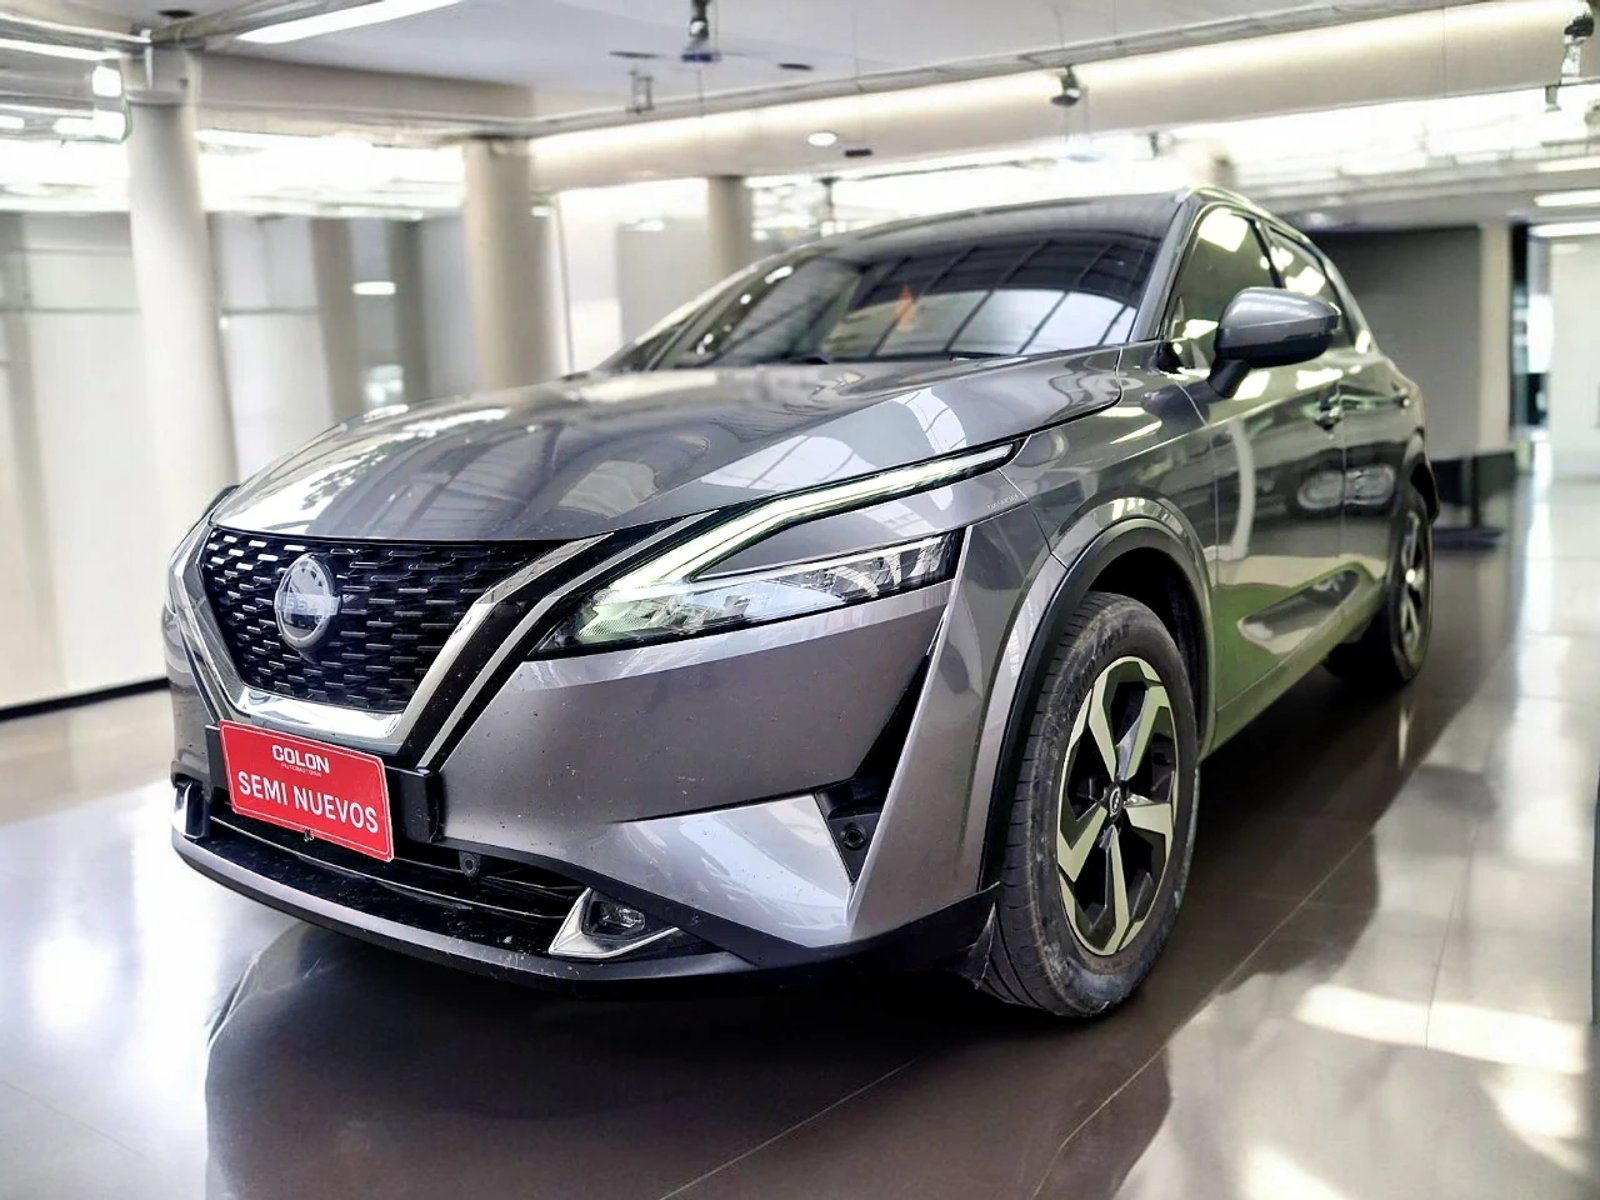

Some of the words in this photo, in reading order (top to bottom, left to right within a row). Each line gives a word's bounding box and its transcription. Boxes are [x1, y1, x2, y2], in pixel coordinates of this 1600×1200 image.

[272, 744, 330, 774] COLON
[237, 770, 288, 806] SEMI
[293, 785, 379, 834] NUEVOS
